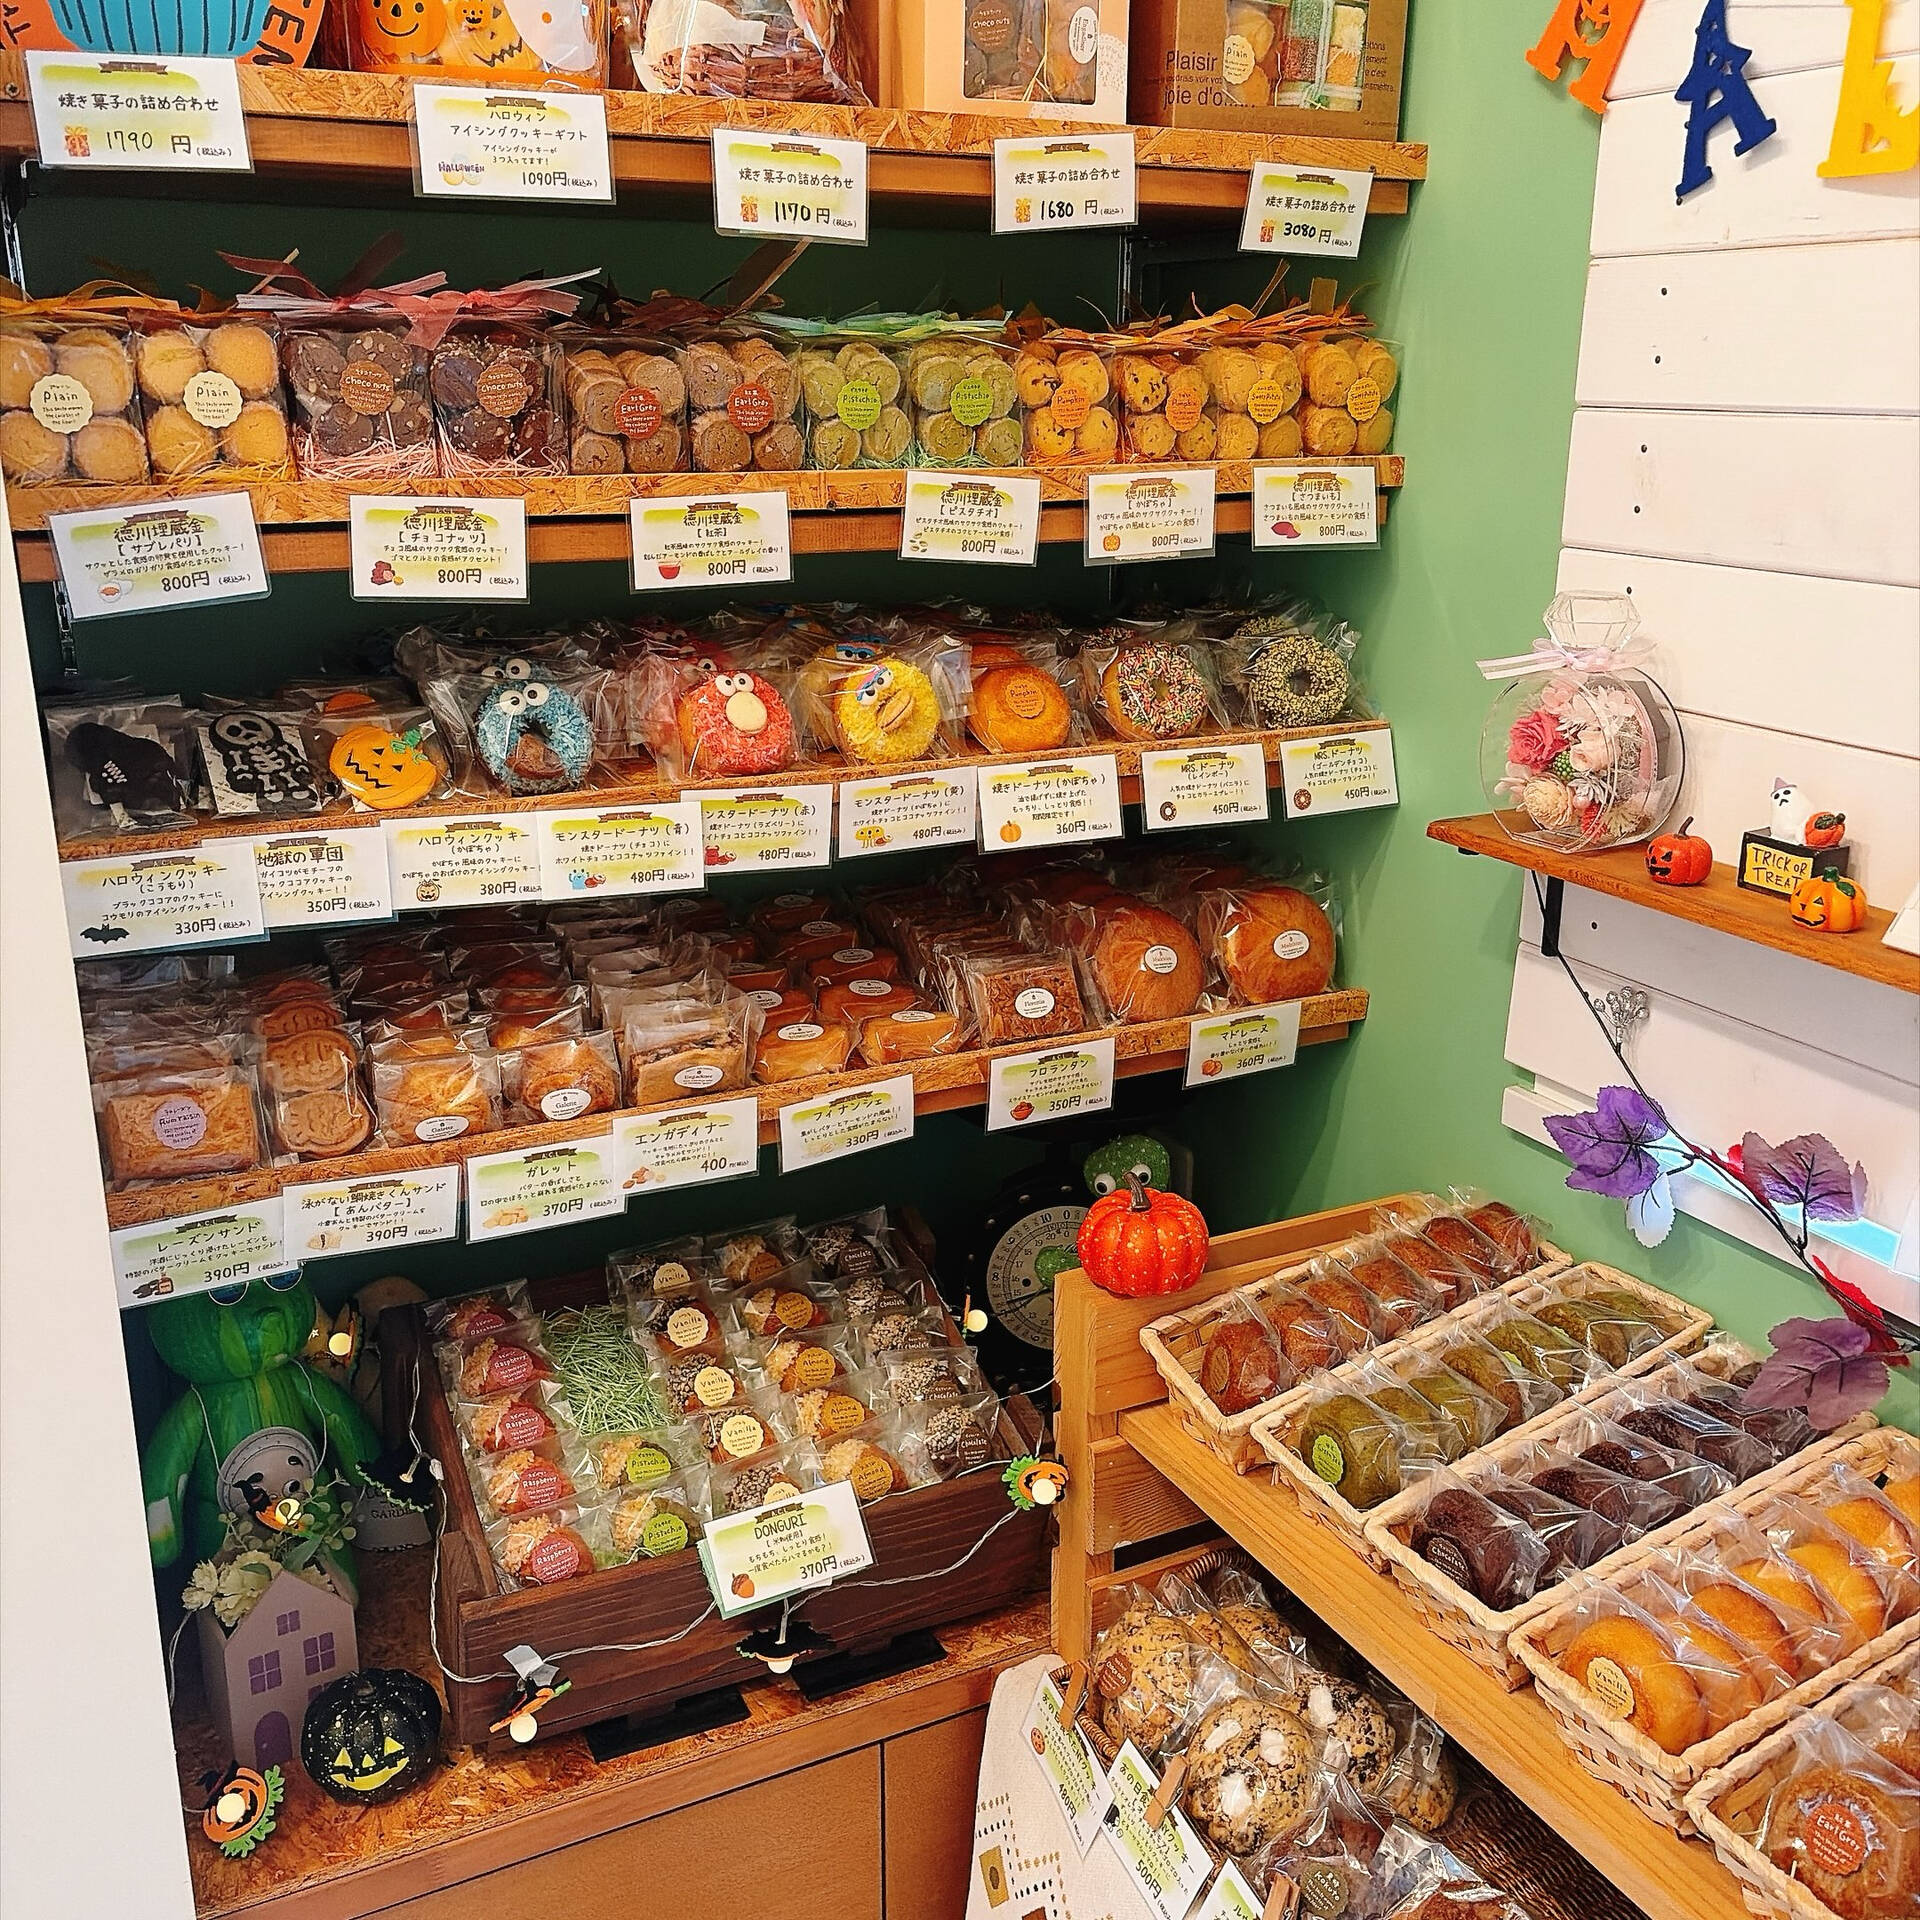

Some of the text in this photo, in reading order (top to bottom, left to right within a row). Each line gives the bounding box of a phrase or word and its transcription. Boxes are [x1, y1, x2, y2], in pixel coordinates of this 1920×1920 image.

[1166, 51, 1217, 71] Plaisir
[490, 111, 546, 122] ハロウィン
[44, 391, 78, 403] Plain
[196, 386, 229, 399] Plain
[706, 805, 816, 819] ンスタードーナツ（赤）
[257, 846, 344, 867] 地獄の軍団
[1752, 847, 1790, 872] TRICK
[526, 1161, 577, 1178] ガレット
[754, 1513, 808, 1540] DONGURI
